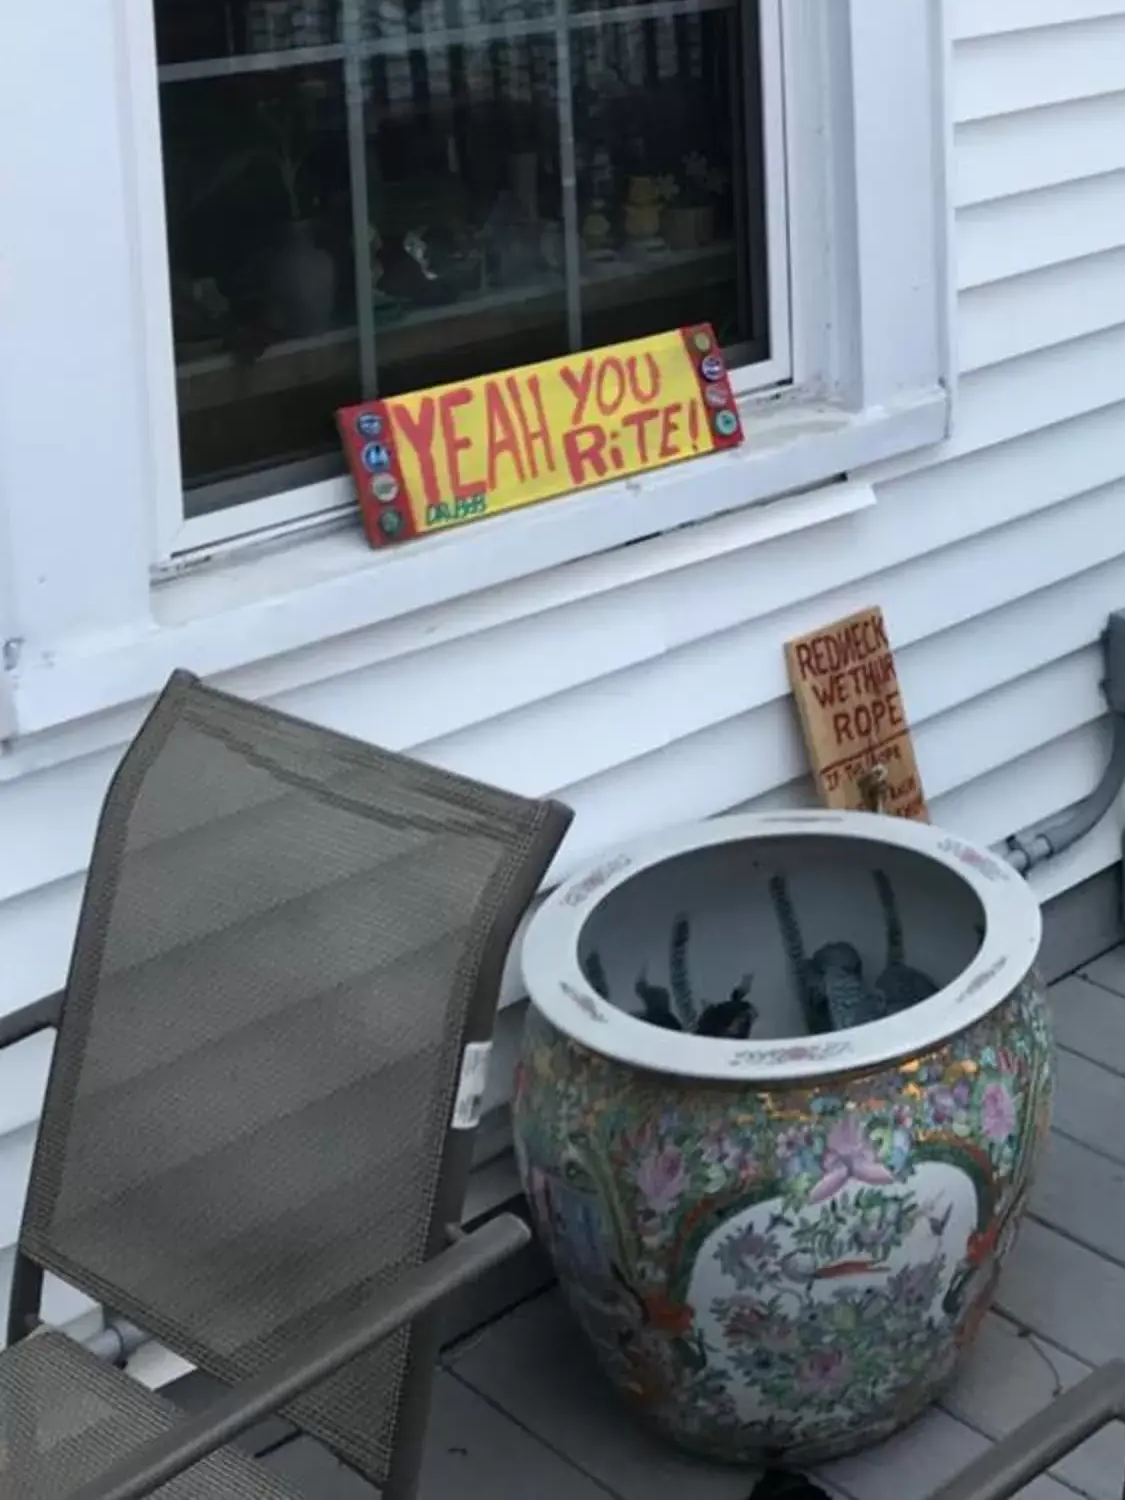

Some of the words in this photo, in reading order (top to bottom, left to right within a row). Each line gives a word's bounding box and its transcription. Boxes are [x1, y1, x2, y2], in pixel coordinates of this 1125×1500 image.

[388, 372, 556, 504] YEAH
[559, 351, 662, 425] YOU
[795, 615, 890, 680] REDNECK
[832, 690, 904, 745] ROPE
